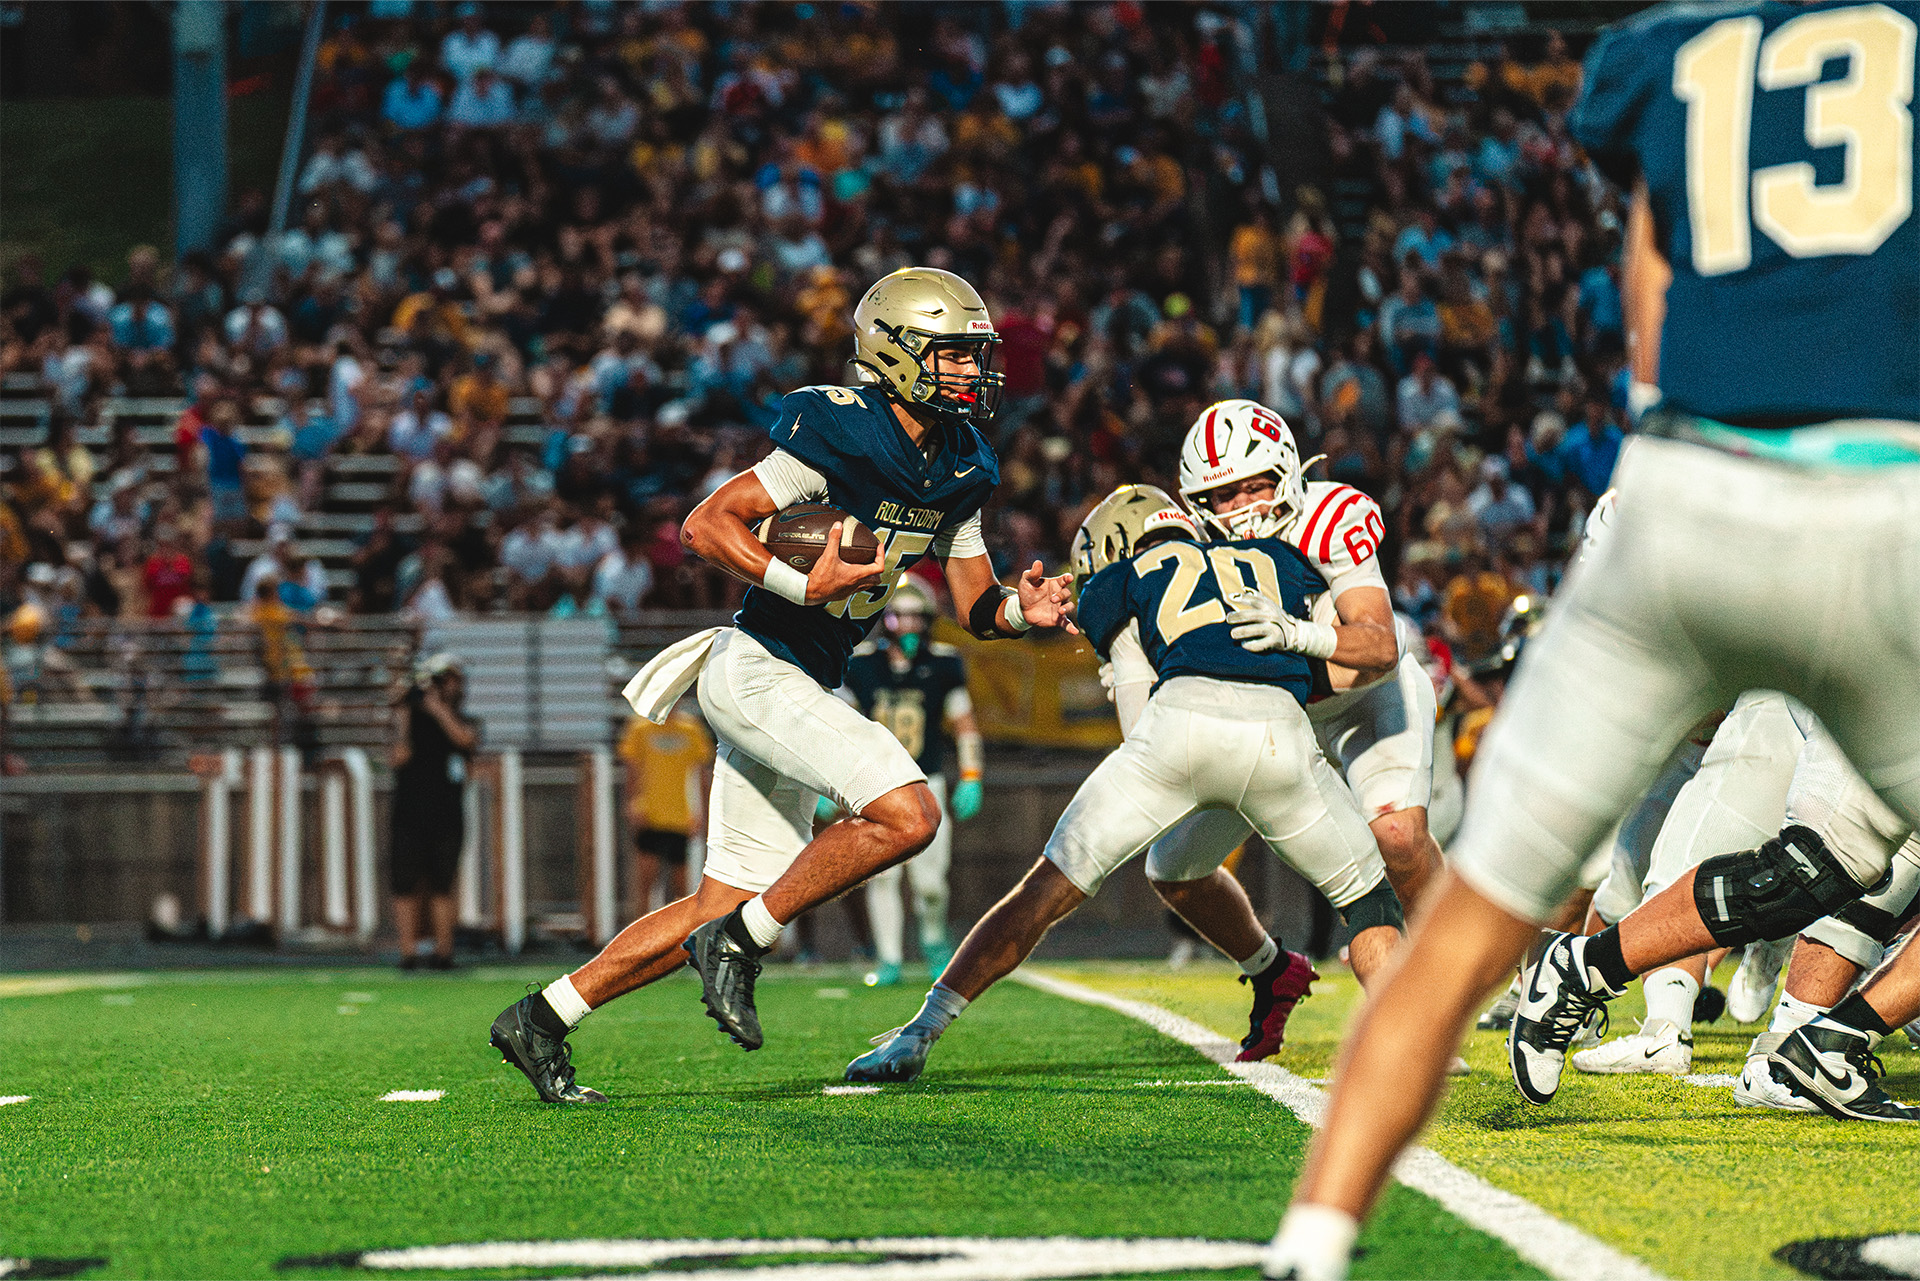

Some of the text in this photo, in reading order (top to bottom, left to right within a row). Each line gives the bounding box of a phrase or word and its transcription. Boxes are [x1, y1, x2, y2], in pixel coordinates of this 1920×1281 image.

[1672, 3, 1918, 277] 13
[1251, 408, 1282, 443] 60
[1203, 467, 1234, 483] Riddell
[875, 501, 945, 530] ROLL STORM
[1343, 509, 1386, 566] 60
[1132, 540, 1283, 646] 20
